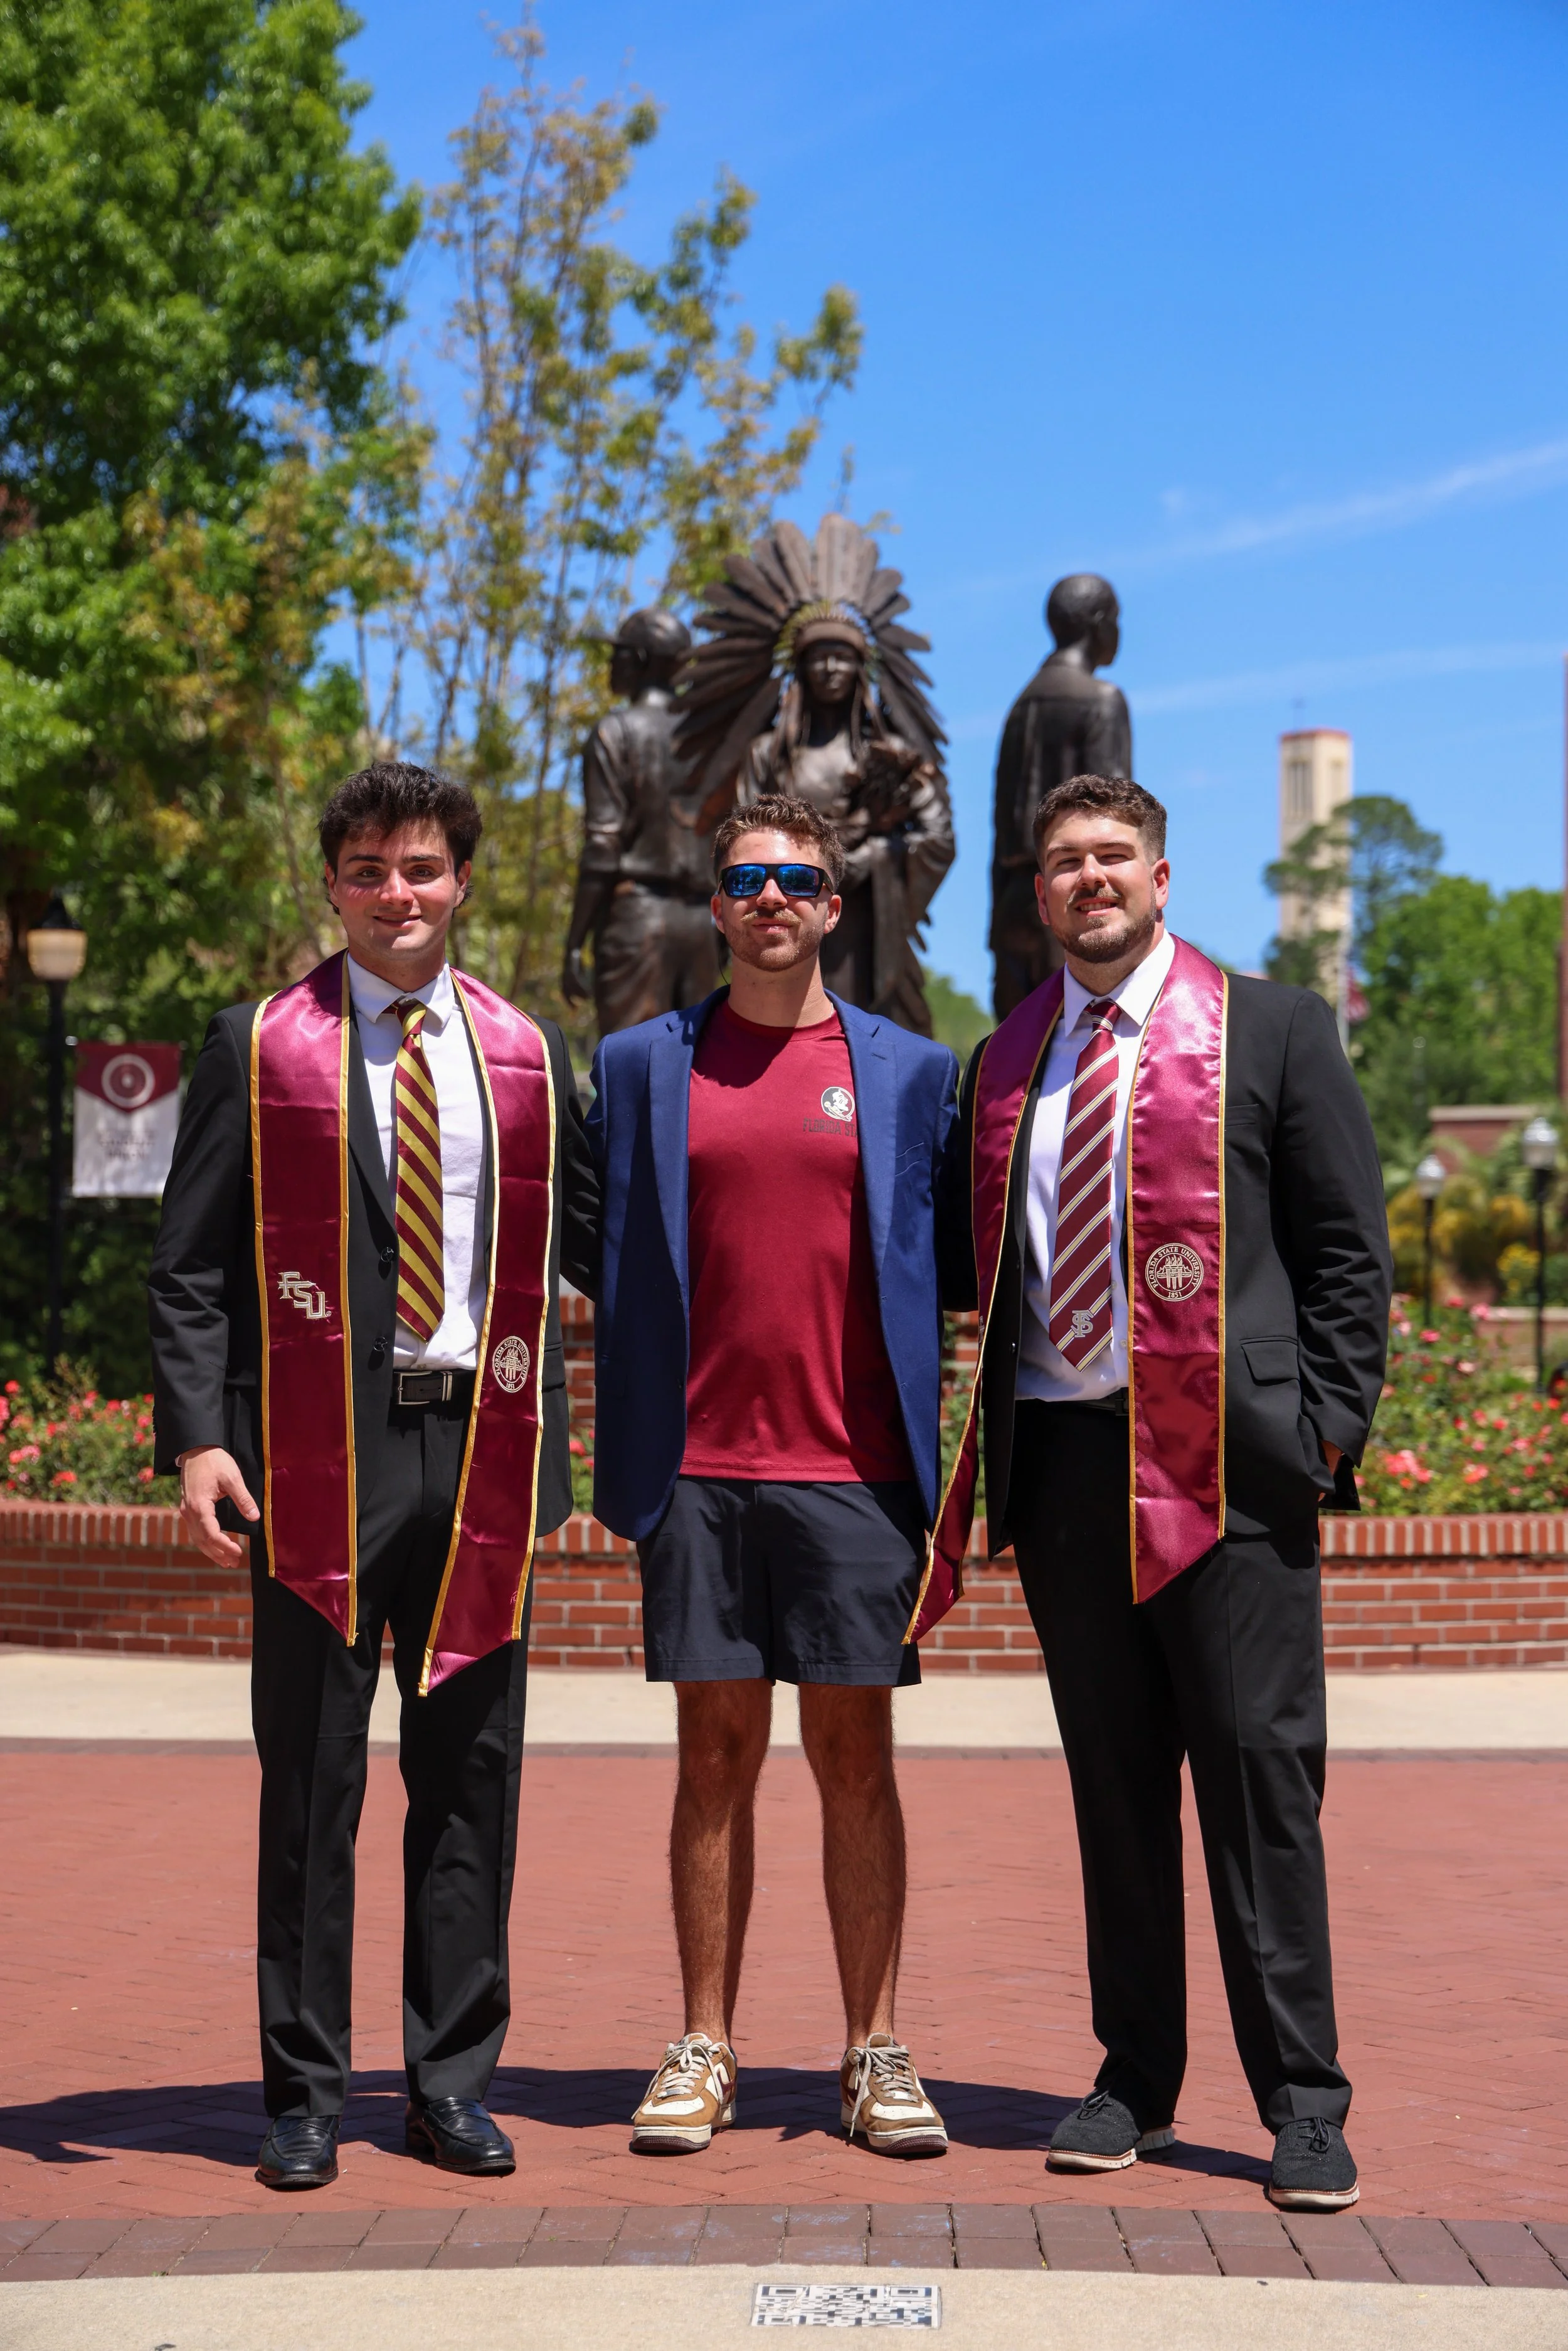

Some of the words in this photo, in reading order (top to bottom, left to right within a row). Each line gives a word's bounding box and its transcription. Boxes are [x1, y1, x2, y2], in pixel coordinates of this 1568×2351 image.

[803, 1118, 842, 1135] FLORIDA
[1148, 1257, 1159, 1289] FLORIDA
[1158, 1246, 1179, 1258] STATE
[1180, 1248, 1200, 1287] UNIVERSITY
[277, 1271, 328, 1319] FSU
[494, 1347, 504, 1377] FLORIDA
[504, 1339, 518, 1347] STATE
[518, 1343, 527, 1381] UNIVERSITY
